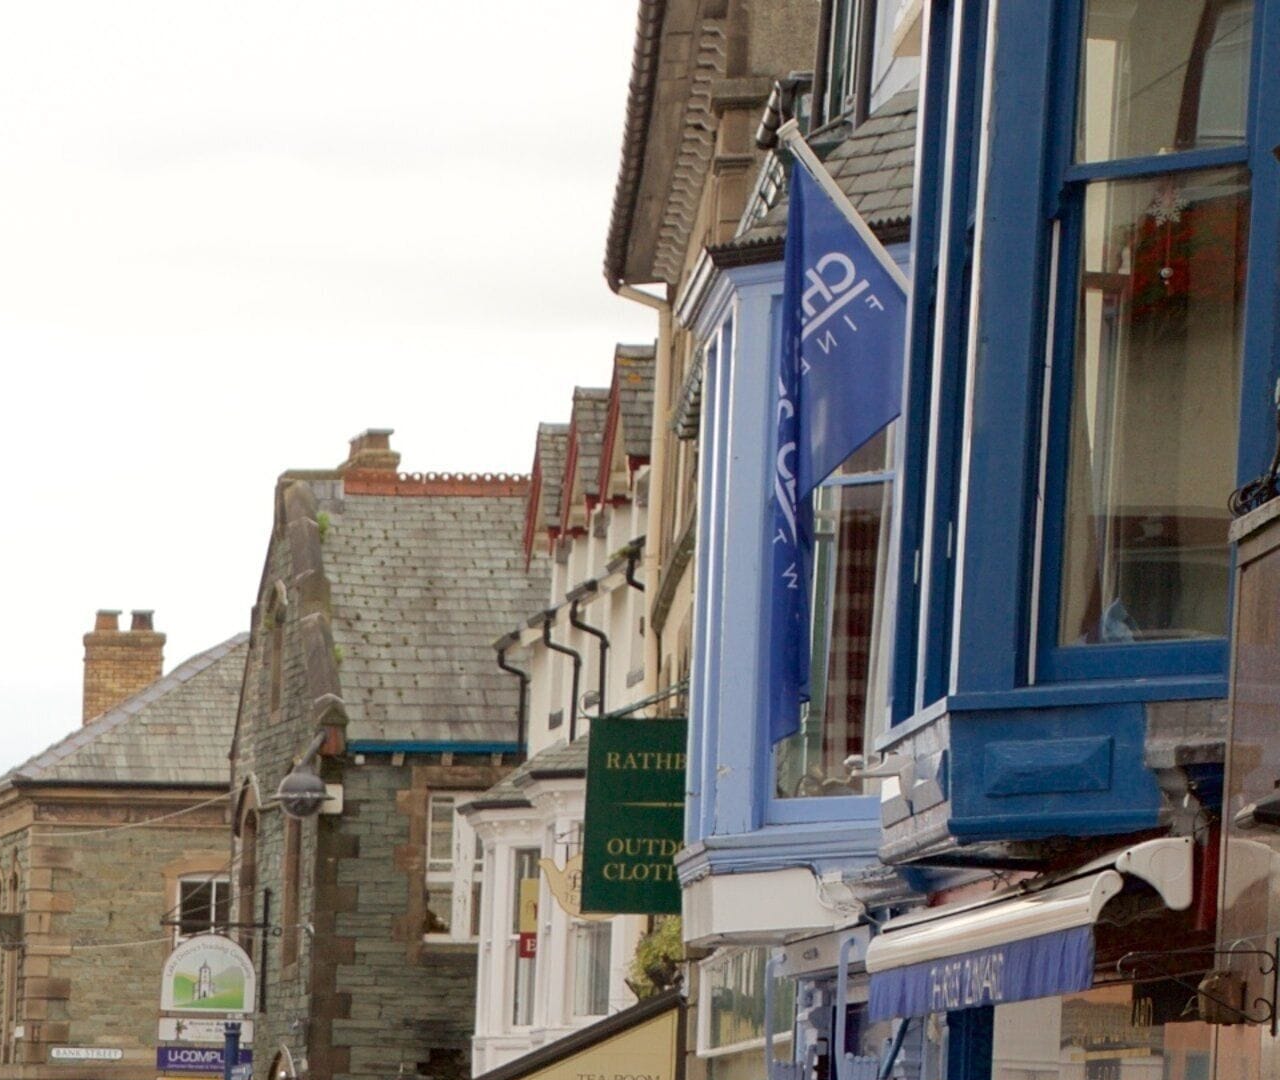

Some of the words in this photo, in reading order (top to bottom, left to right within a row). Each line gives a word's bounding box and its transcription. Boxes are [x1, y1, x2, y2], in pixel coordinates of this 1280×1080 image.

[606, 752, 687, 770] RATHB
[55, 1048, 81, 1057] BANK
[86, 1049, 118, 1058] STREET
[168, 1050, 225, 1063] U-COMPL
